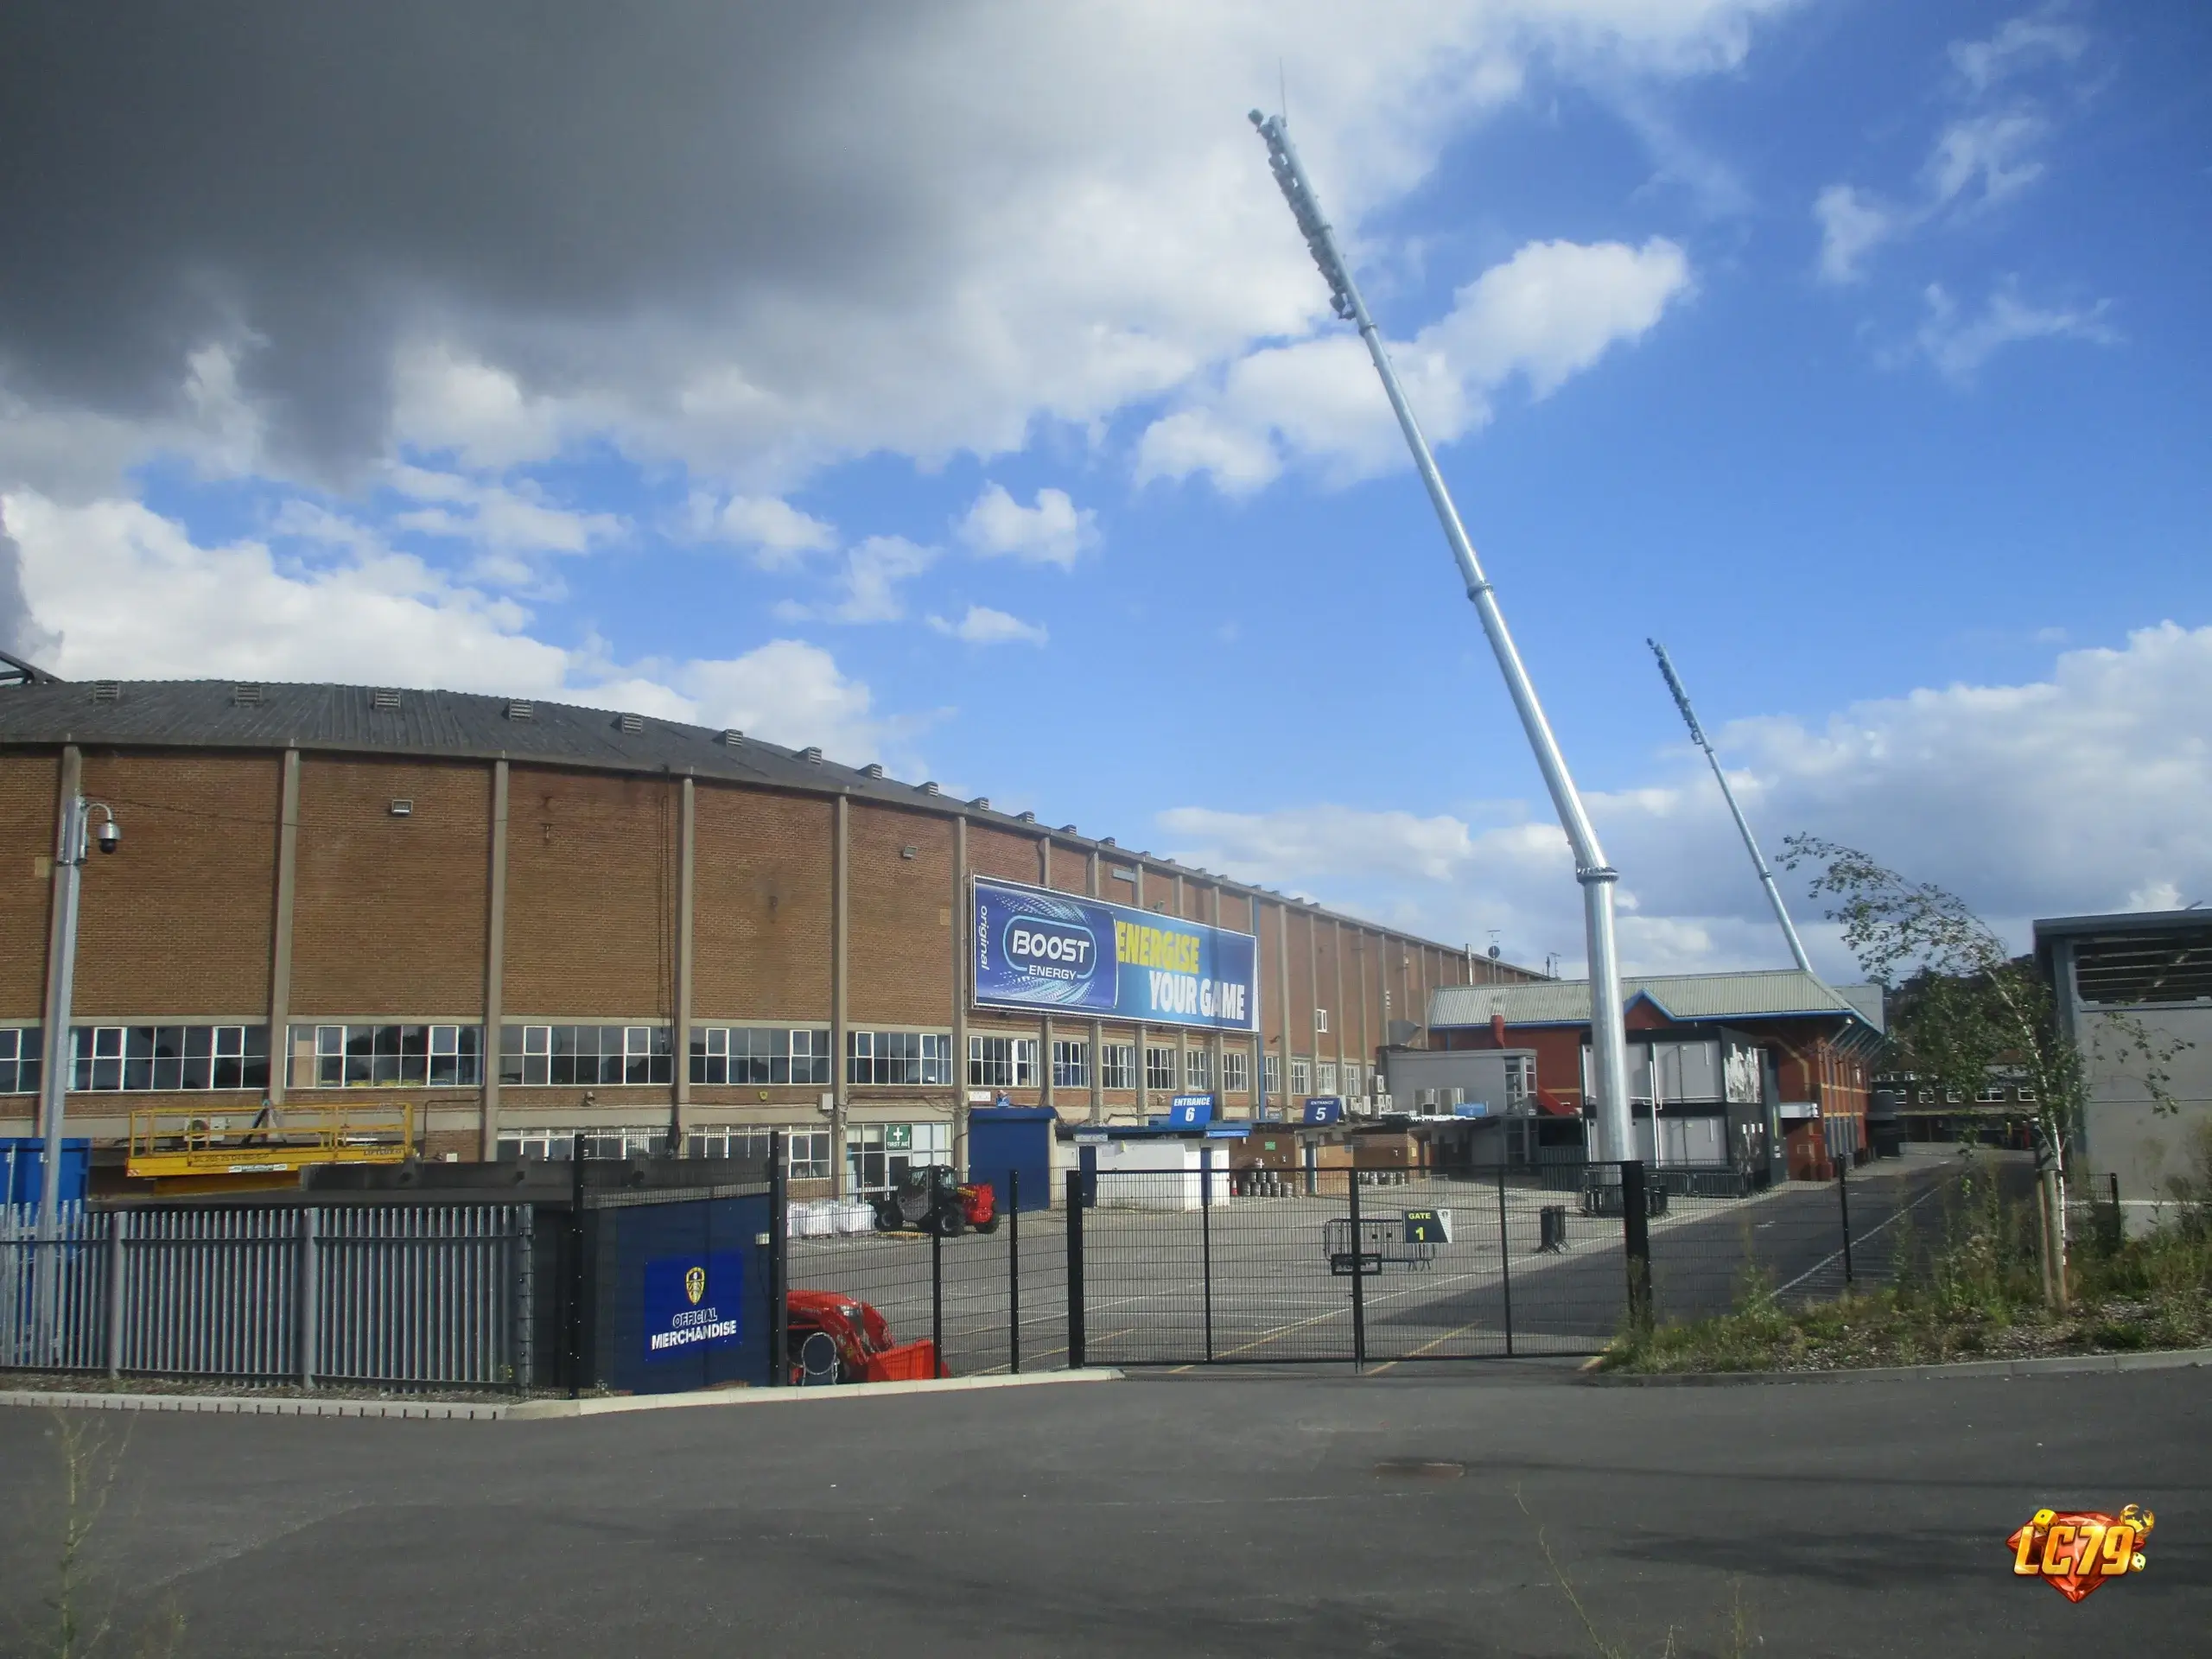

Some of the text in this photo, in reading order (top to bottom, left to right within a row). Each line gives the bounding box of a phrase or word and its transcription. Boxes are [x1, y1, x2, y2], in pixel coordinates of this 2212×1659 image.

[978, 906, 990, 970] original
[1012, 930, 1090, 963] BOOST
[1117, 921, 1199, 974] ENERGISE
[1028, 964, 1077, 981] ENERGY
[1149, 970, 1244, 1020] YOUR GAME
[1173, 1097, 1211, 1107] ENTRANCE
[1185, 1107, 1195, 1122] 6
[1315, 1107, 1326, 1122] 5
[1415, 1226, 1424, 1241] 1
[672, 1306, 718, 1329] OFFICIAL
[651, 1319, 737, 1351] MERCHANDISE
